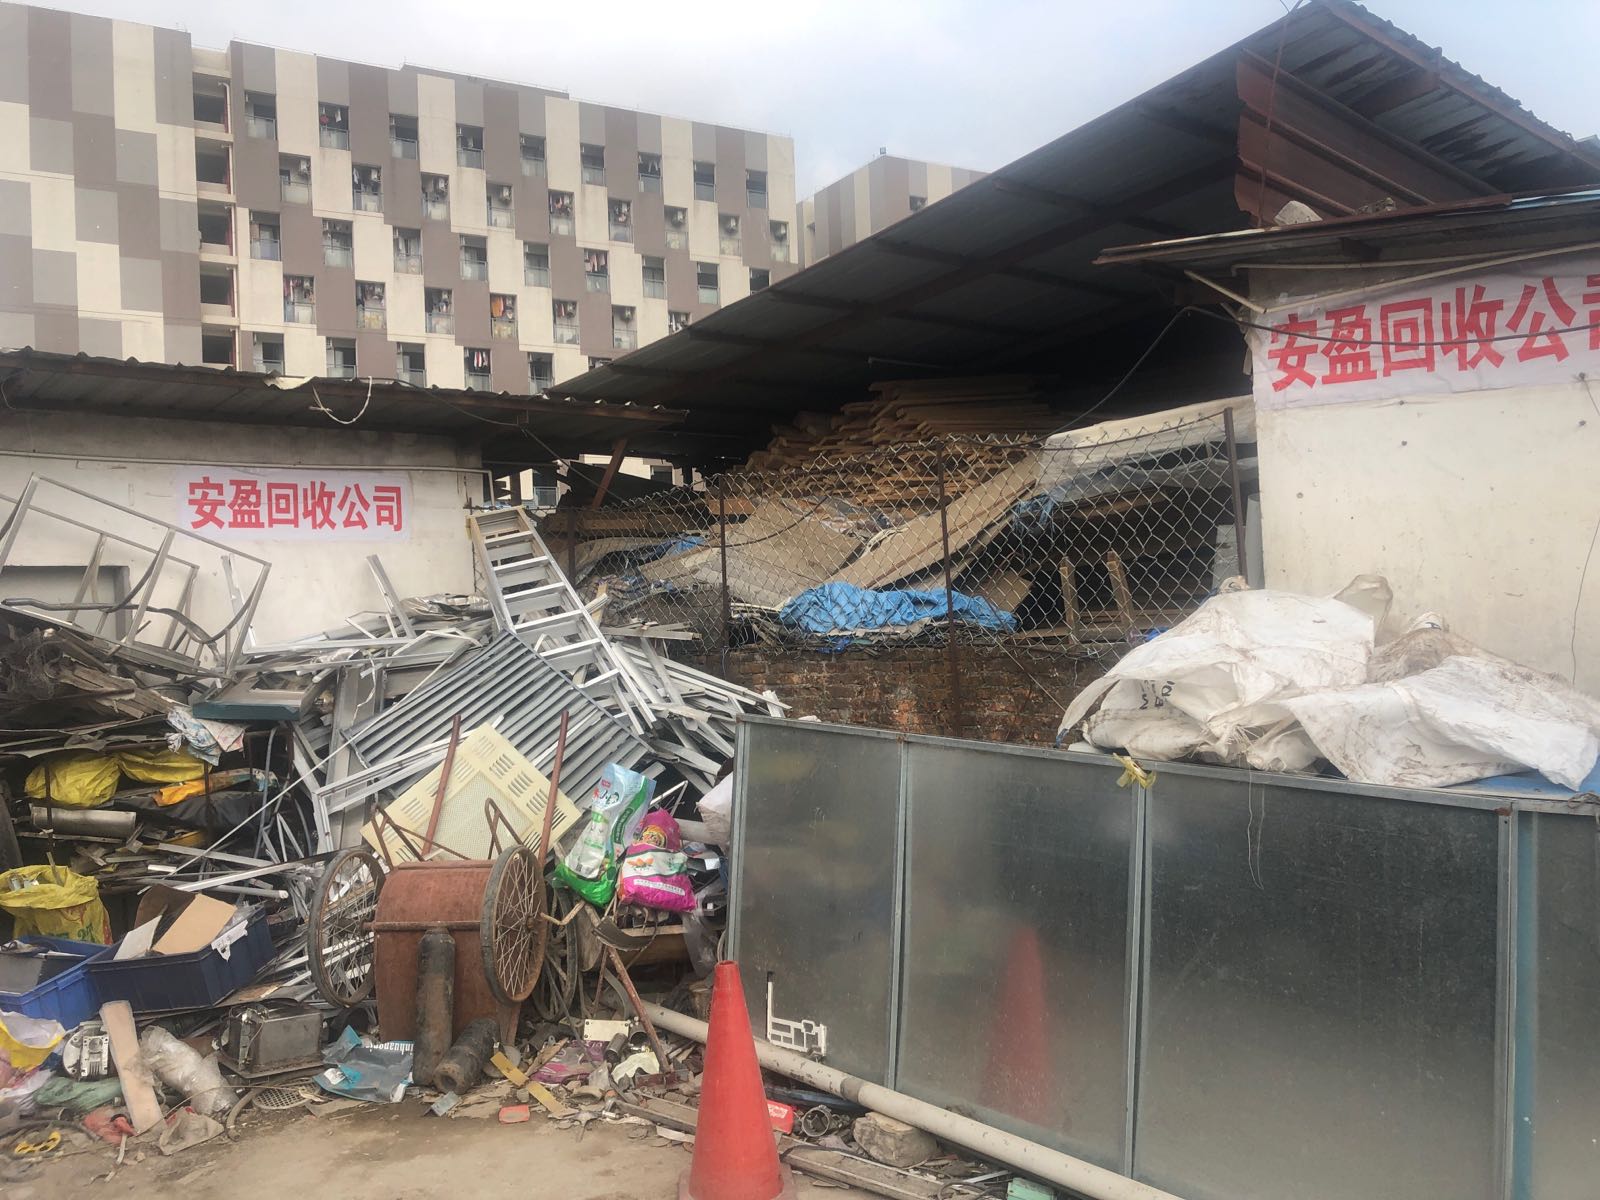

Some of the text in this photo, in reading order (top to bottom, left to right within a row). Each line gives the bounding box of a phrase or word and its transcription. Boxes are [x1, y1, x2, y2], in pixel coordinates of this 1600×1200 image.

[187, 476, 403, 532] 安盈回收公司
